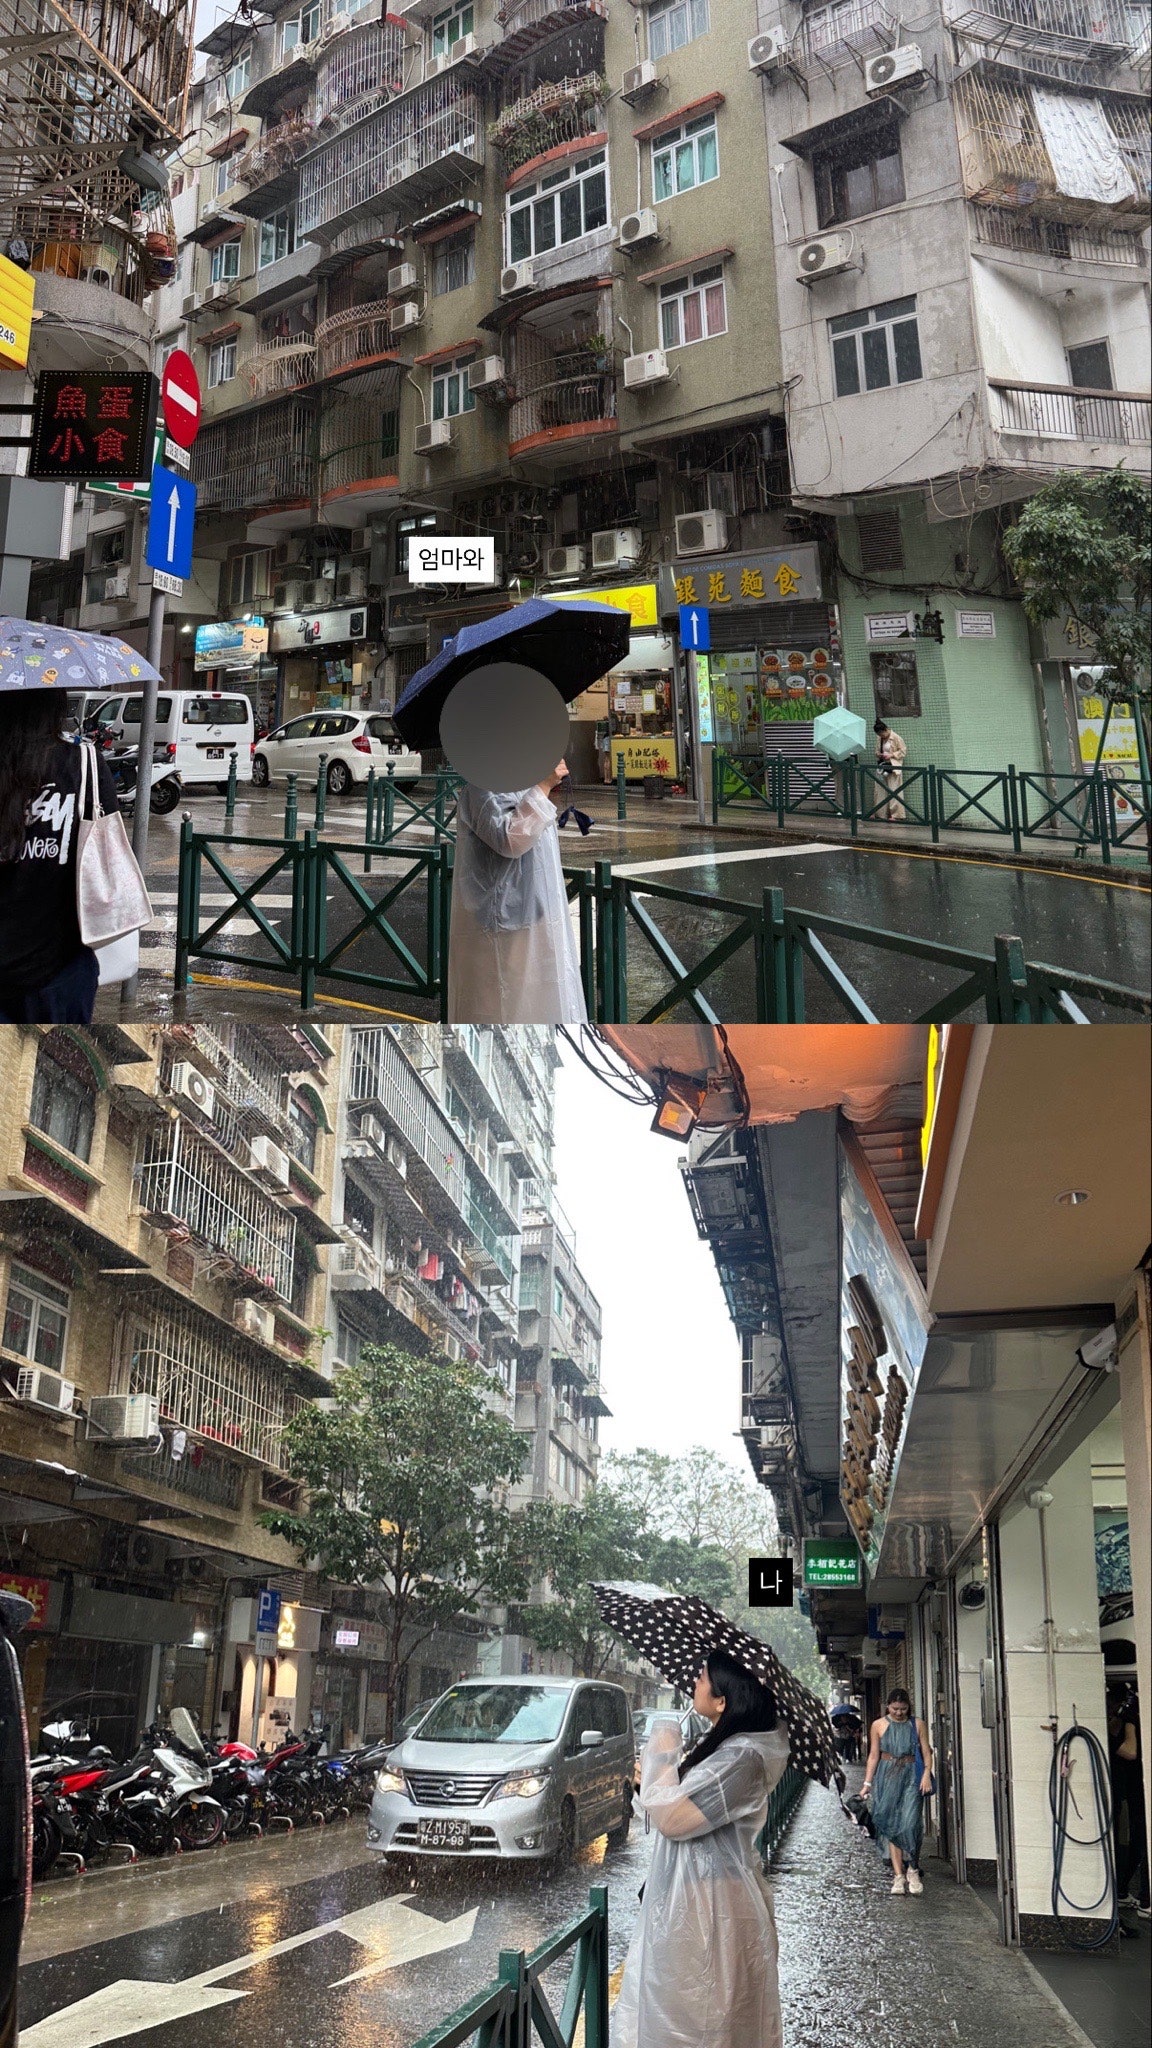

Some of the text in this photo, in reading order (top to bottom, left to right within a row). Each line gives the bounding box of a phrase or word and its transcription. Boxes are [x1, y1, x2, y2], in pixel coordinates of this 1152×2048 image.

[53, 384, 134, 420] 魚蛋
[48, 427, 129, 463] 小食
[674, 563, 801, 605] 銀苑麵食
[1082, 696, 1131, 719] 澳門
[259, 1592, 271, 1620] P
[420, 1835, 464, 1846] M-87-98
